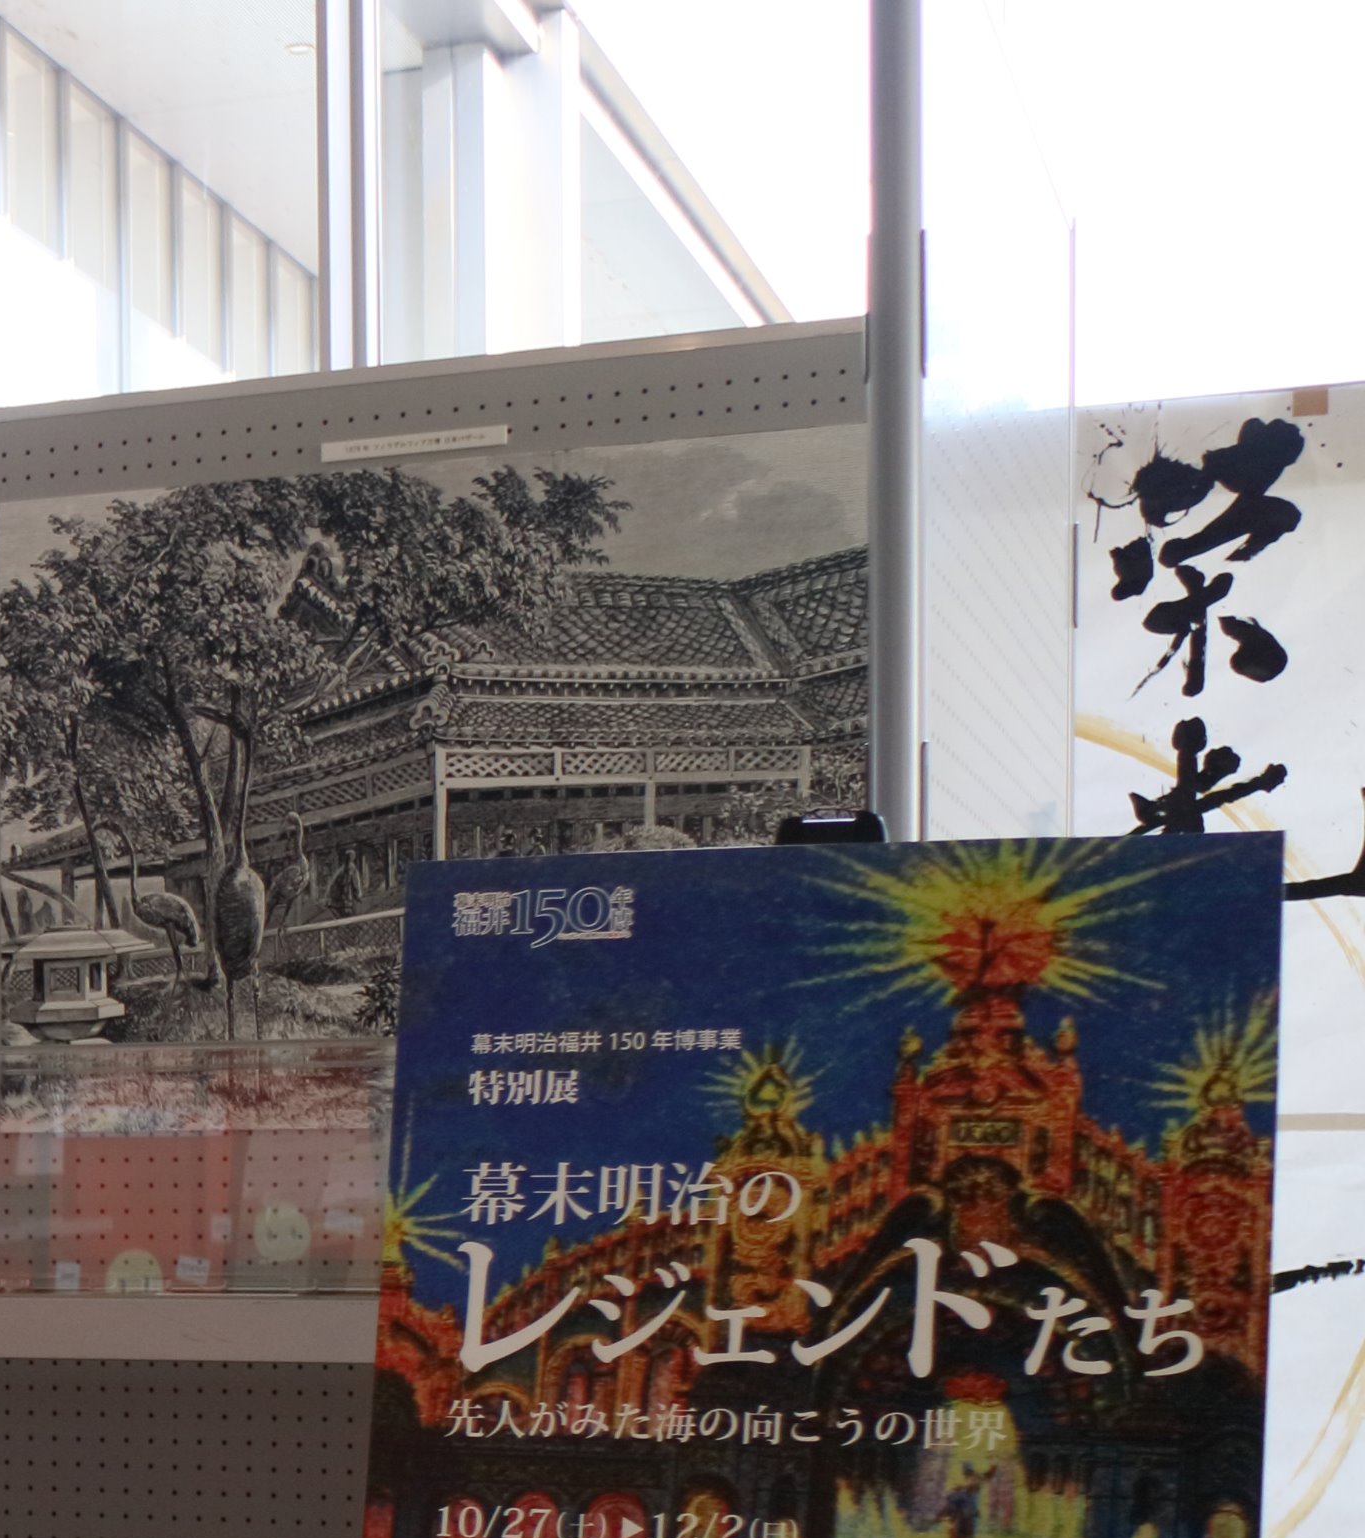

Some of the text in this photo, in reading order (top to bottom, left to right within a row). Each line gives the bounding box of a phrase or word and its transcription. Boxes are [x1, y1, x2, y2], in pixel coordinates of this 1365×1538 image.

[610, 1033, 645, 1051] 150
[468, 1069, 580, 1105] 特別展
[460, 1161, 801, 1226] 幕末明治の
[457, 1238, 1205, 1378] レジェンドたち
[444, 1398, 1008, 1451] 先人がみた海の向こうの世界
